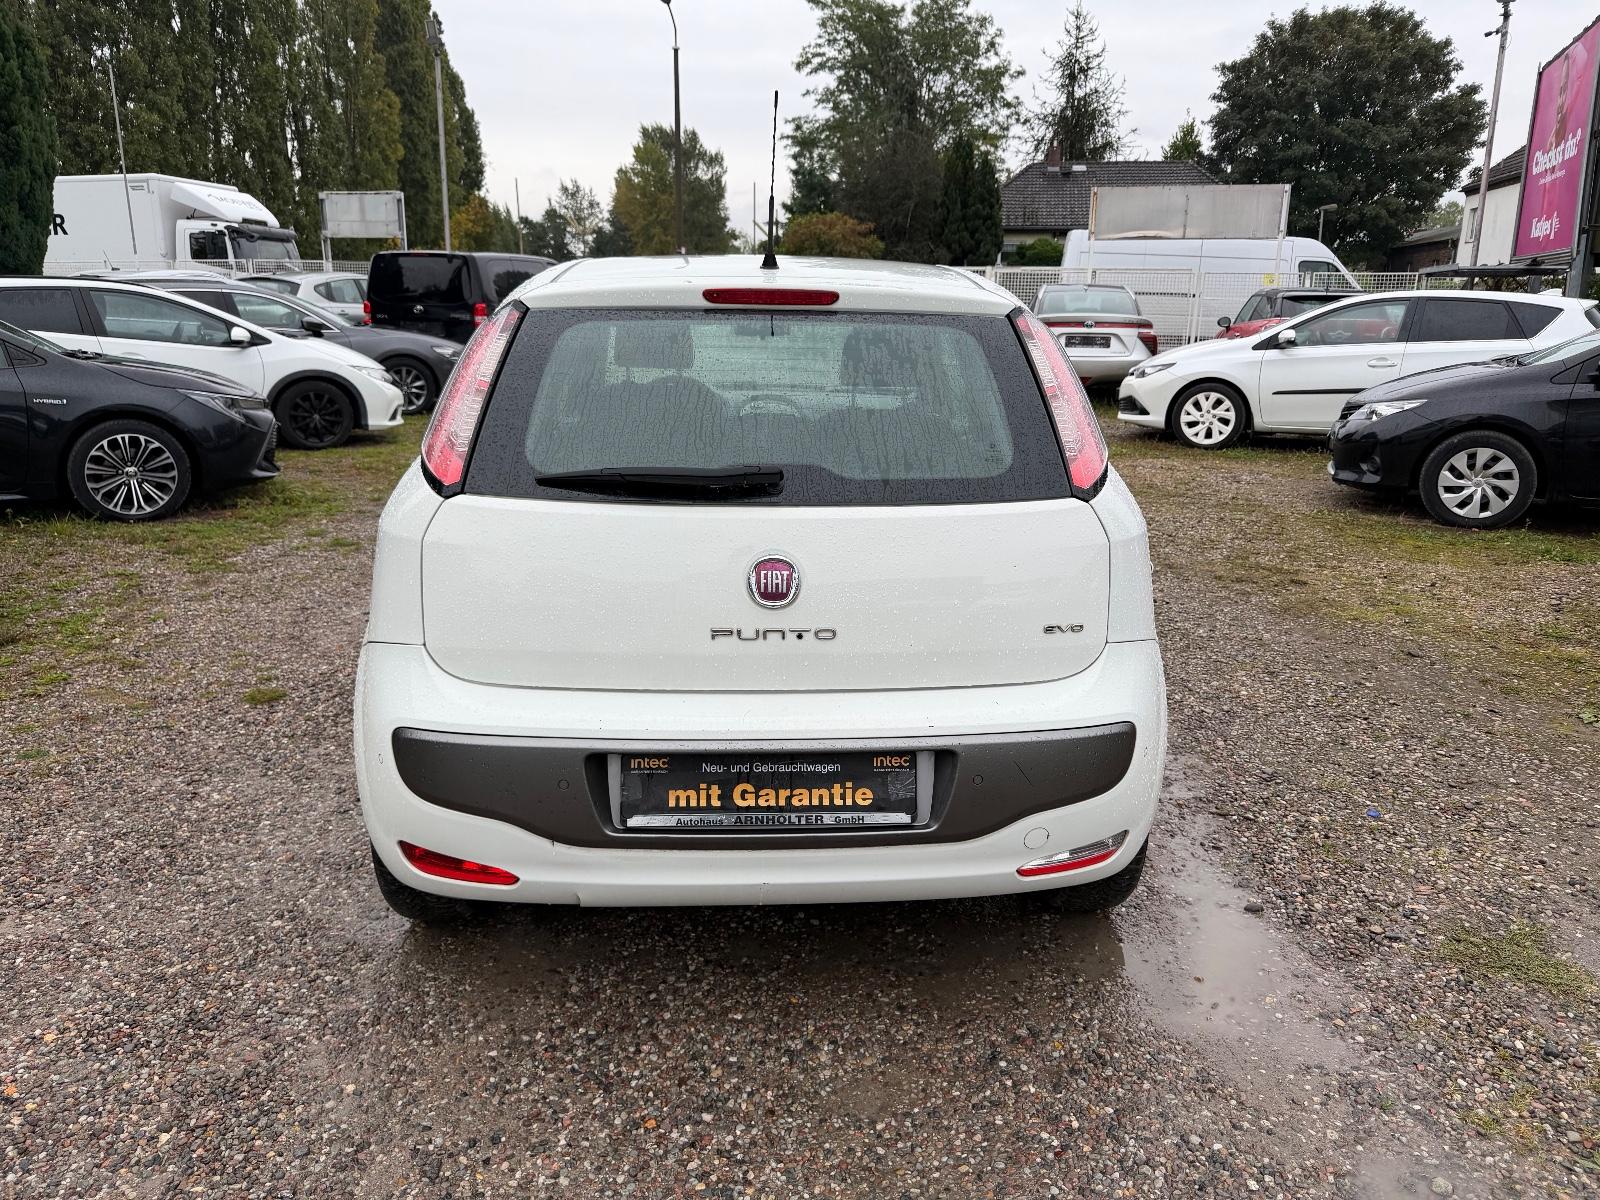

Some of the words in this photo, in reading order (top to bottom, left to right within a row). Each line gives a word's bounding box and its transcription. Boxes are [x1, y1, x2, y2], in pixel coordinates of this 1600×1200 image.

[1531, 214, 1552, 242] Katjes
[760, 570, 789, 593] FIAT
[710, 627, 837, 641] PUNTO
[1043, 623, 1084, 635] EVO
[630, 757, 668, 769] intec
[873, 755, 910, 767] intec
[702, 762, 727, 773] Neu-
[730, 762, 750, 773] und
[752, 762, 841, 774] Gebrauchtwagen
[668, 783, 721, 808] mit
[732, 781, 874, 808] Garantie
[675, 817, 724, 827] Autohaus
[834, 815, 865, 825] GmbH
